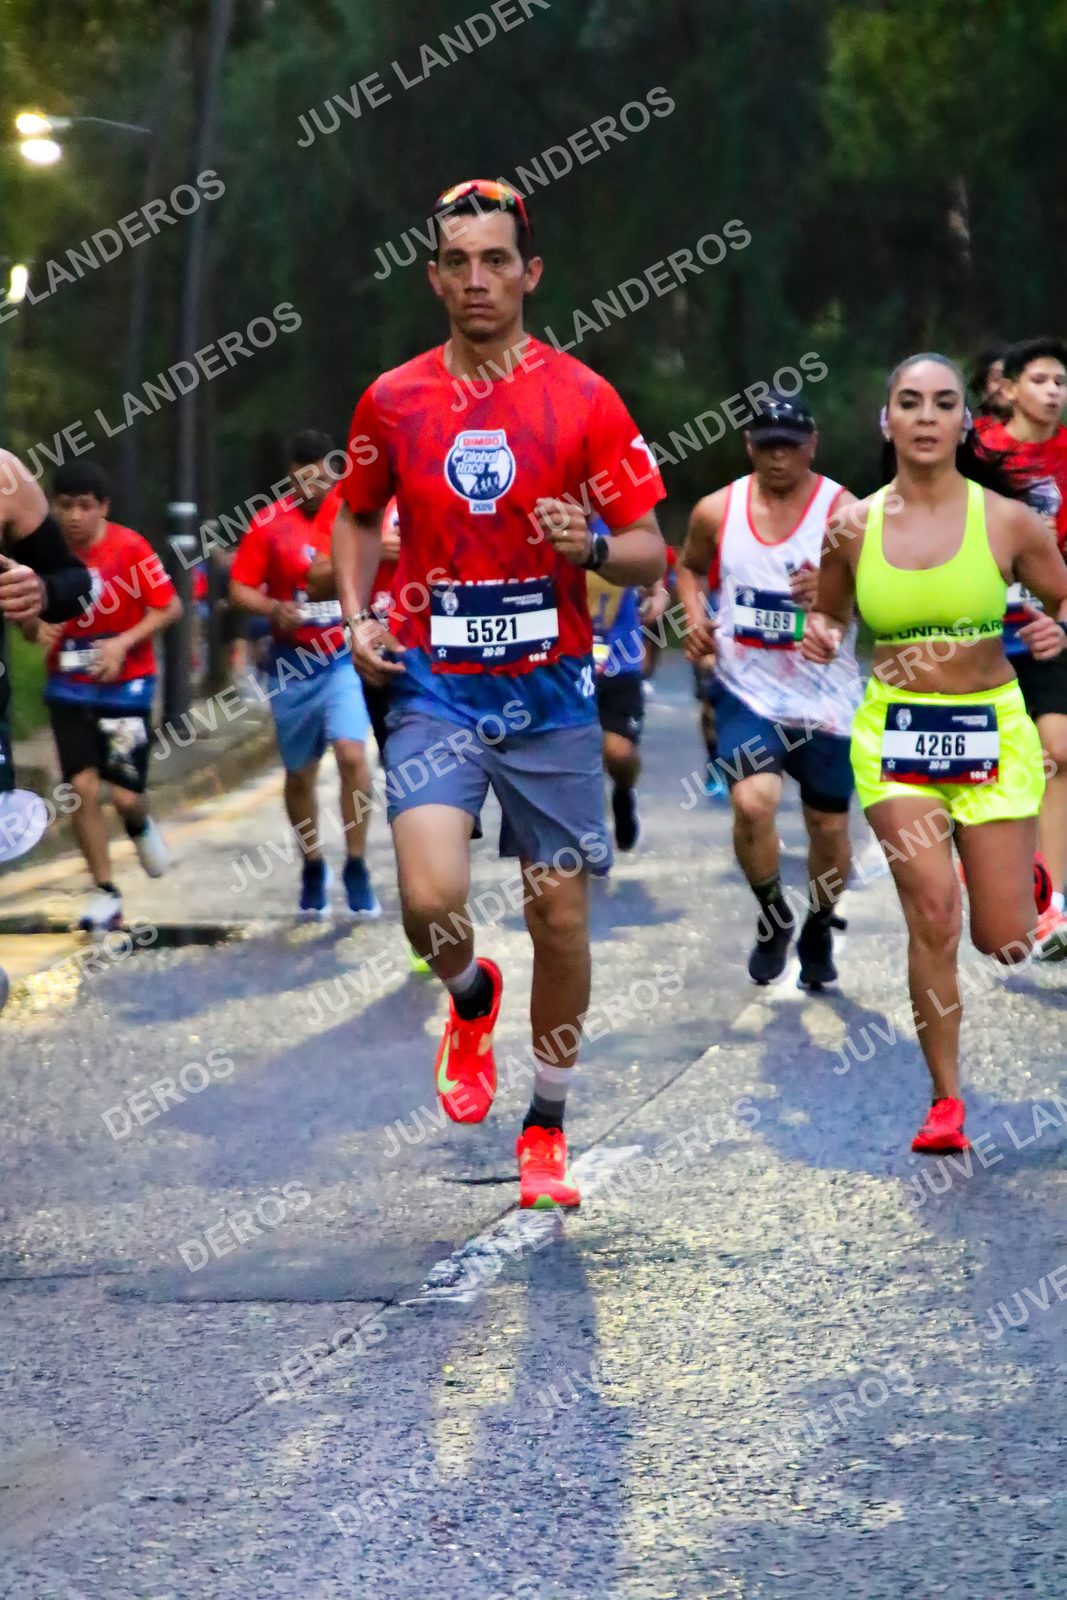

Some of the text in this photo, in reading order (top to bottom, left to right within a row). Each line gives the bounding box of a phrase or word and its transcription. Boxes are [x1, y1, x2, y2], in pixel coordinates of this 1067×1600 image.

[463, 437, 499, 446] BIMBO
[463, 450, 499, 463] Global
[456, 462, 485, 475] Race
[467, 617, 517, 644] 5521
[898, 624, 974, 640] UNDER
[915, 734, 966, 757] 4266
